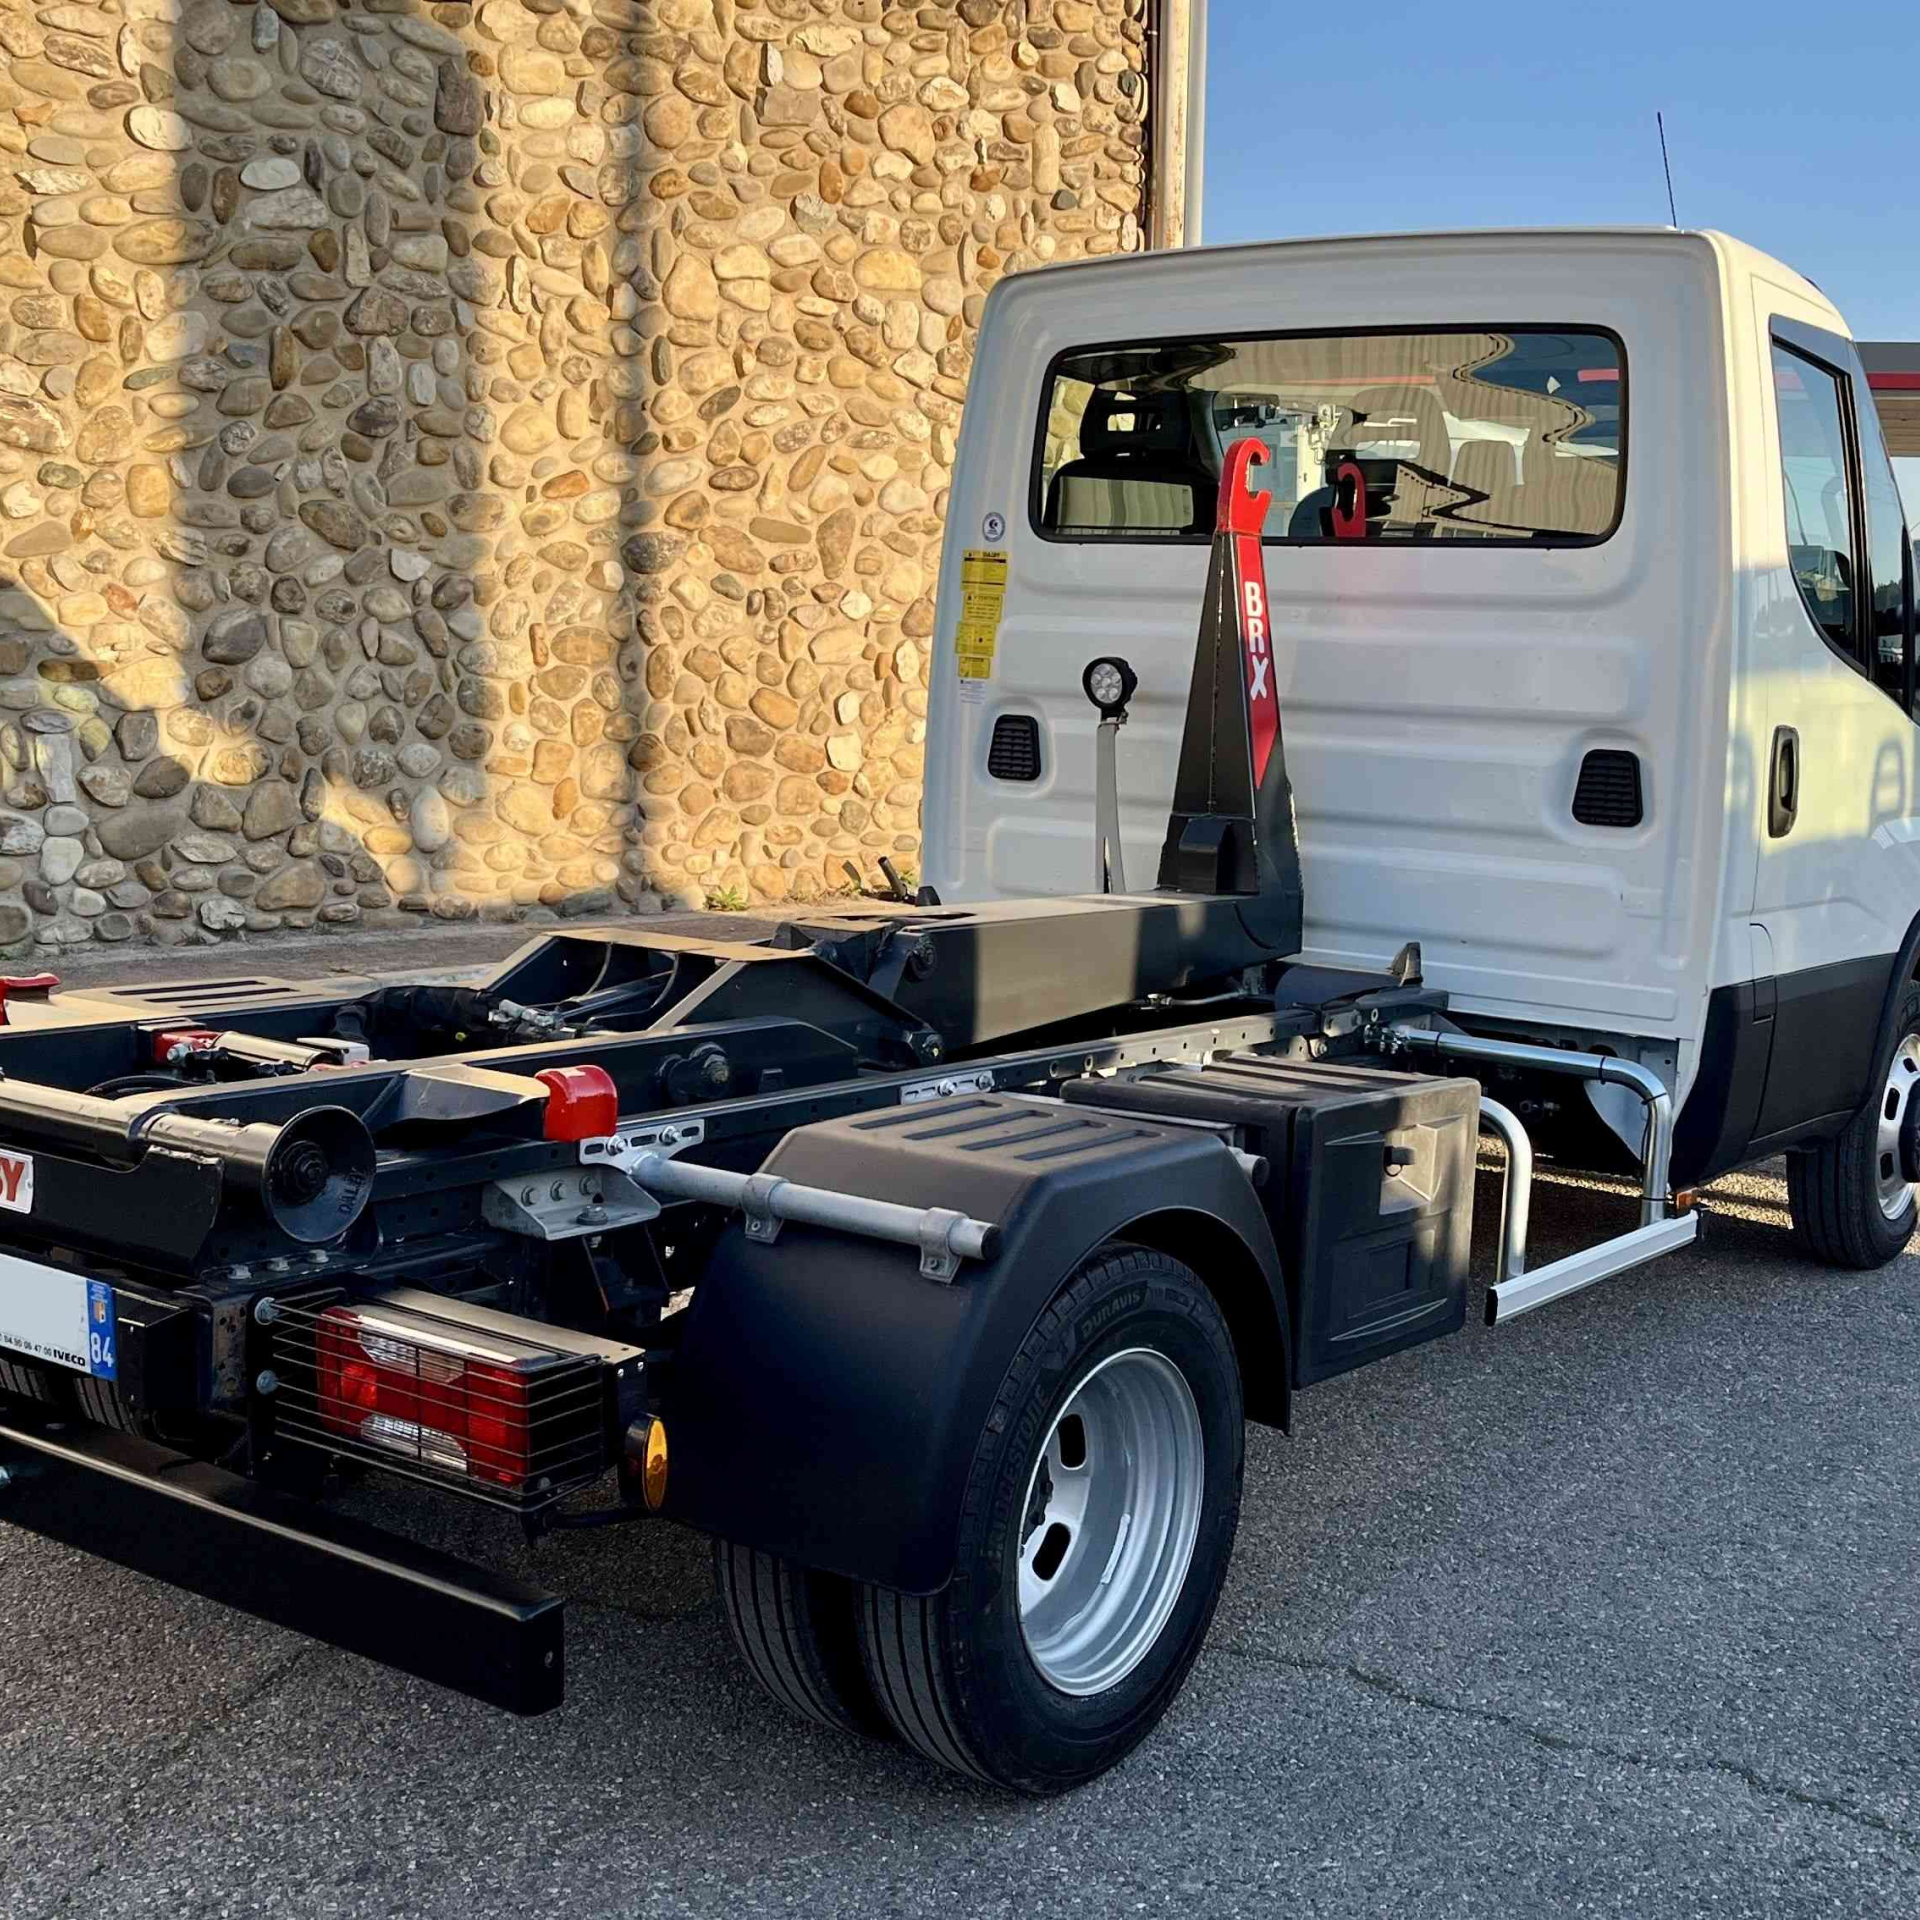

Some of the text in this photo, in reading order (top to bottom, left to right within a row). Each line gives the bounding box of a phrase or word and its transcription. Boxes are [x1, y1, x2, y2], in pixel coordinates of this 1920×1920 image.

[1244, 580, 1270, 701] BRX
[0, 1157, 25, 1202] Y
[1081, 1289, 1141, 1337] DURAVIS
[53, 1348, 86, 1367] IVECO
[90, 1332, 114, 1368] 84
